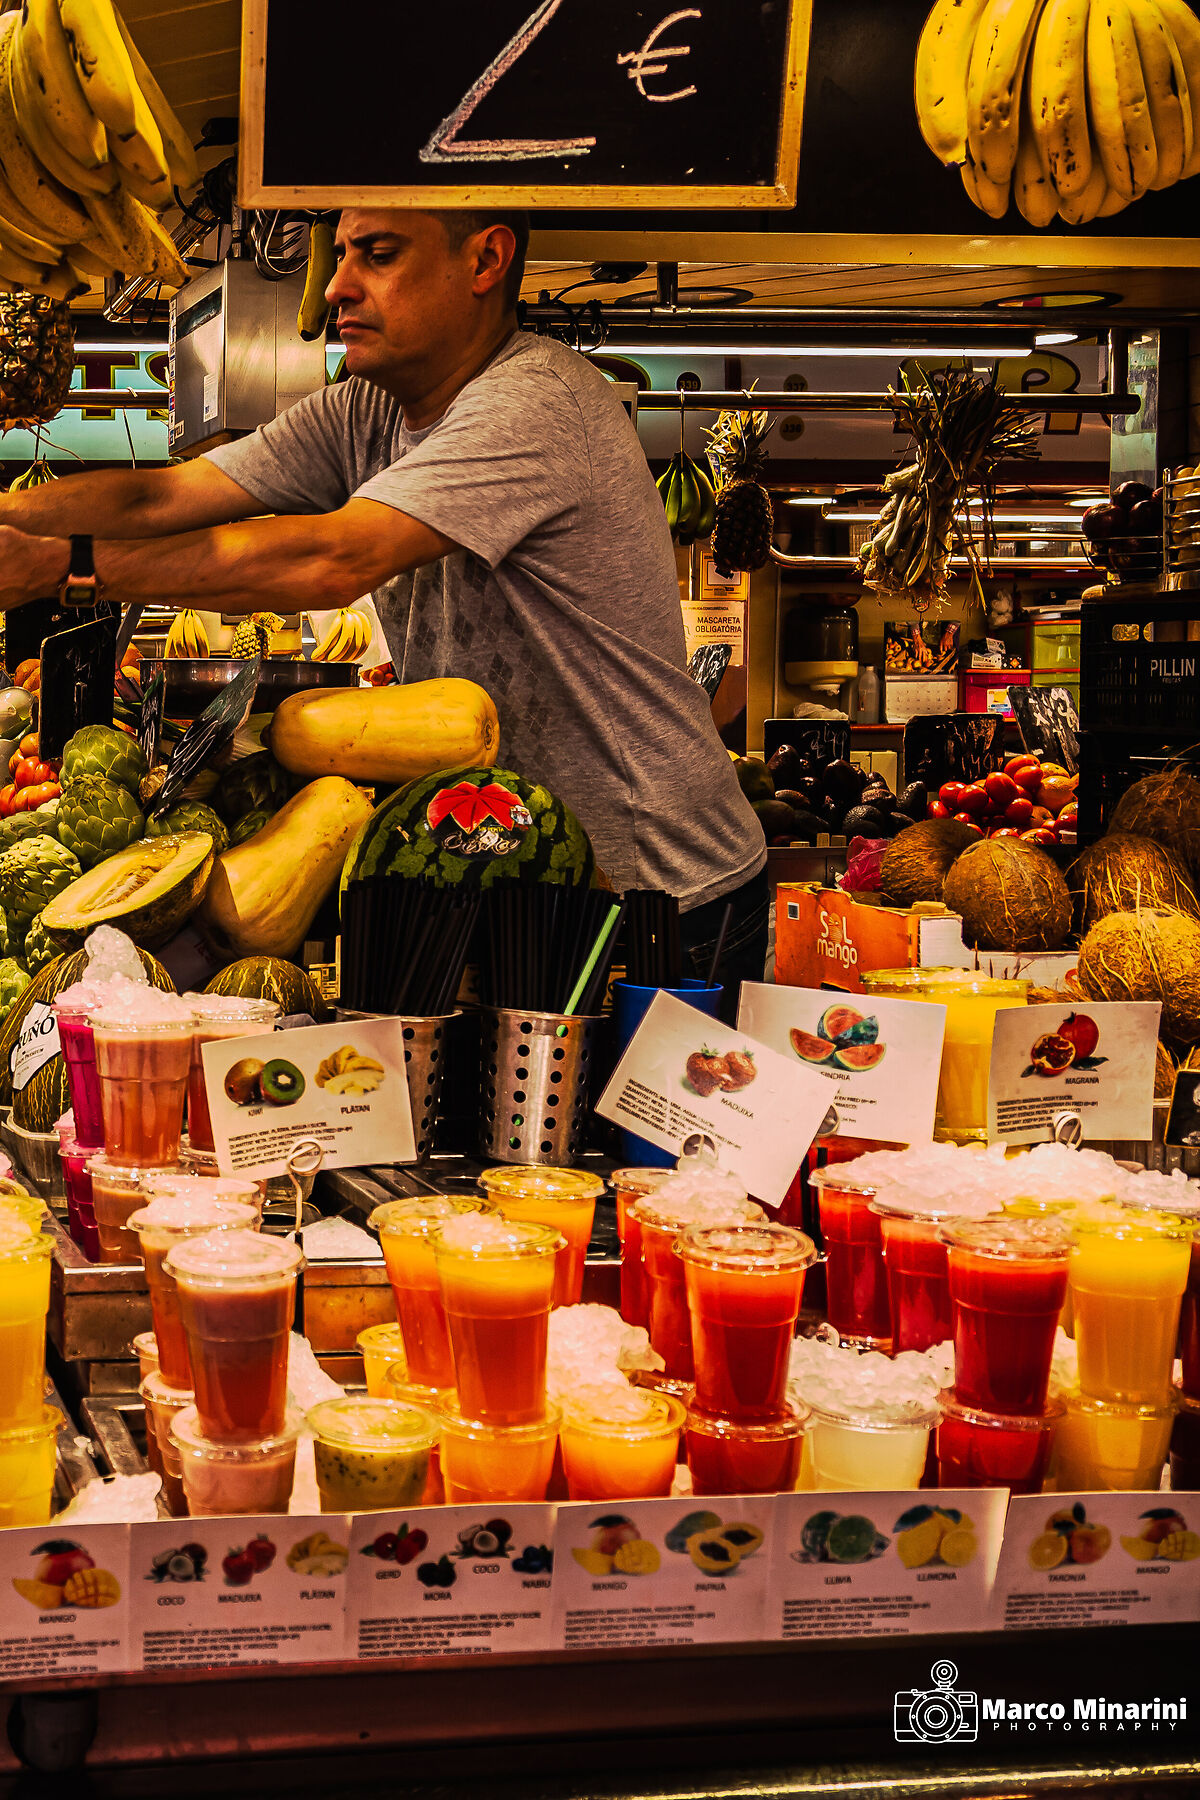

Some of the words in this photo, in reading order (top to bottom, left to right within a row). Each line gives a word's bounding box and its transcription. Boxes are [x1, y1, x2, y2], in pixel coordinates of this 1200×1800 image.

[617, 8, 702, 102] €
[697, 616, 741, 624] MASCARETA
[1150, 658, 1195, 677] PILLIN
[820, 910, 853, 945] SOL
[817, 938, 858, 969] mango
[1065, 1077, 1099, 1085] MAGRANA
[472, 1564, 500, 1574] COCO
